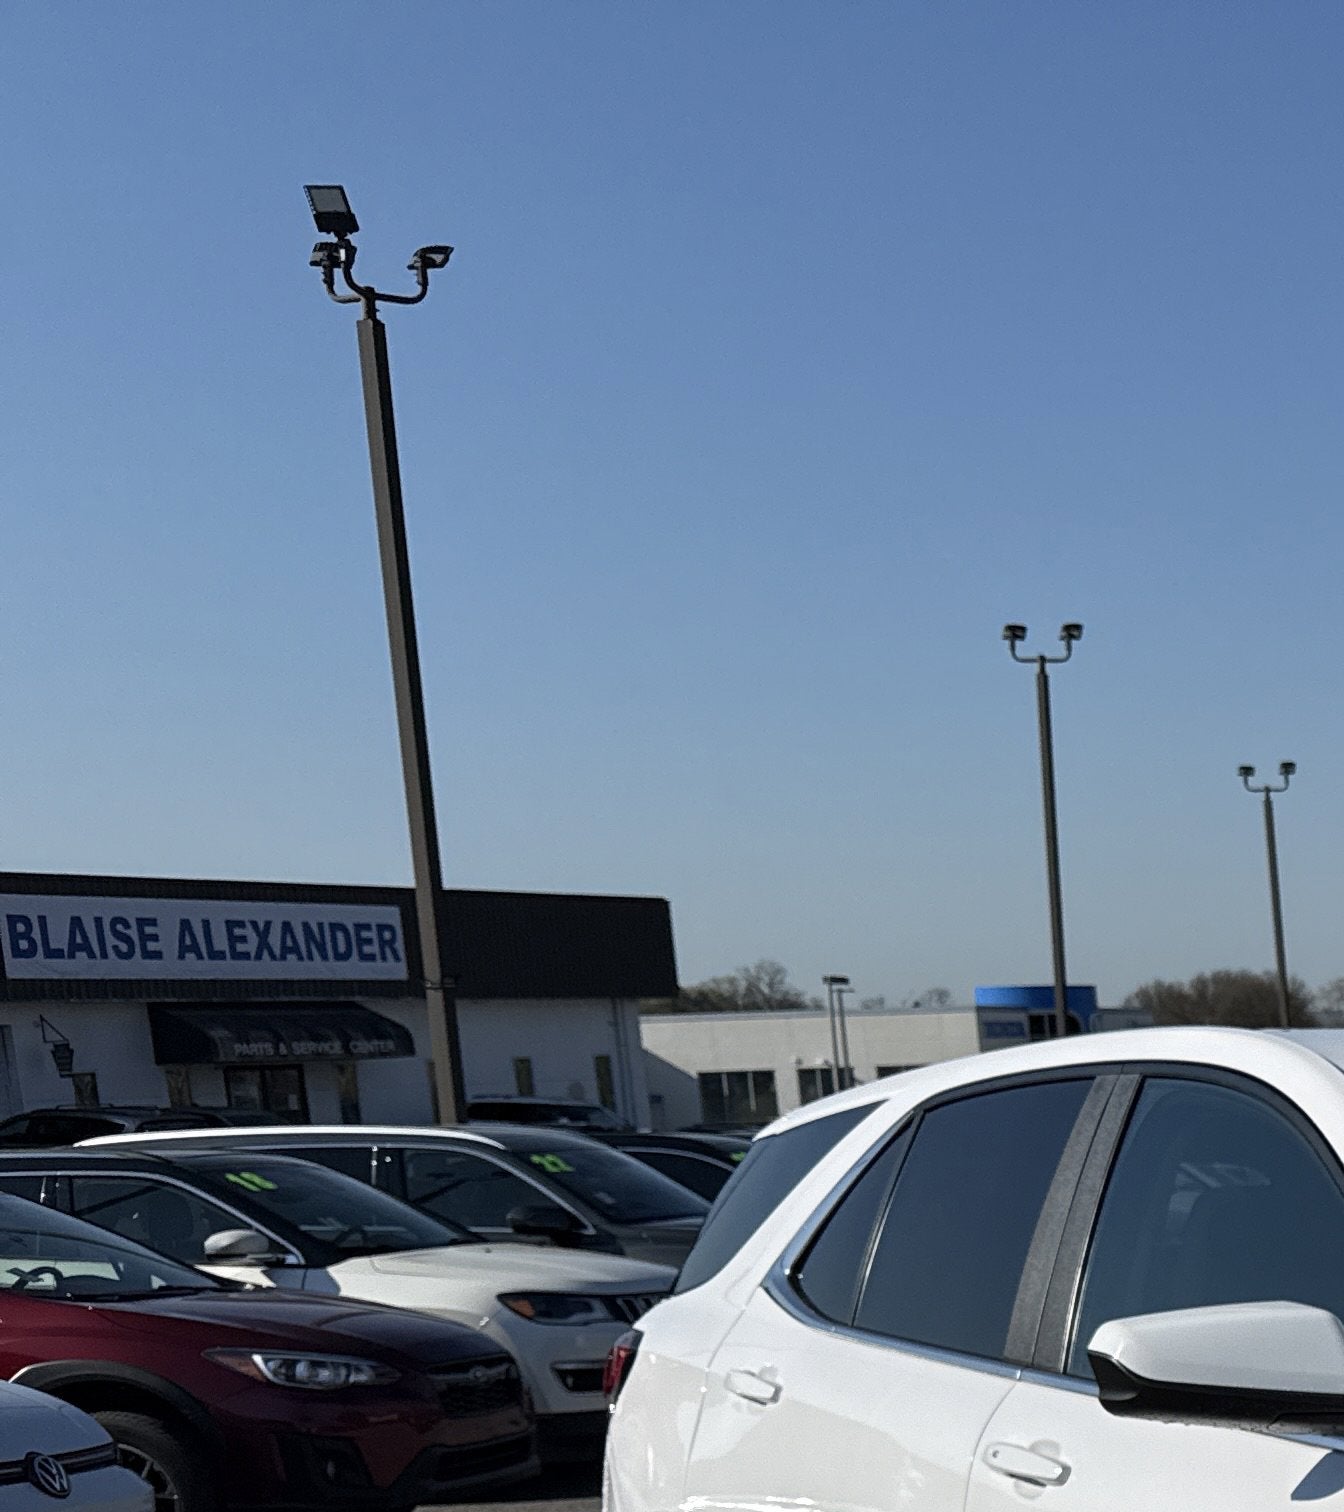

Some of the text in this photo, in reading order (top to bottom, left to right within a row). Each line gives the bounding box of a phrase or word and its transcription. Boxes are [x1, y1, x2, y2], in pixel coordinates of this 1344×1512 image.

[5, 913, 403, 964] BLAISE ALEXANDER
[233, 1042, 274, 1057] PARTS
[279, 1042, 287, 1056] &
